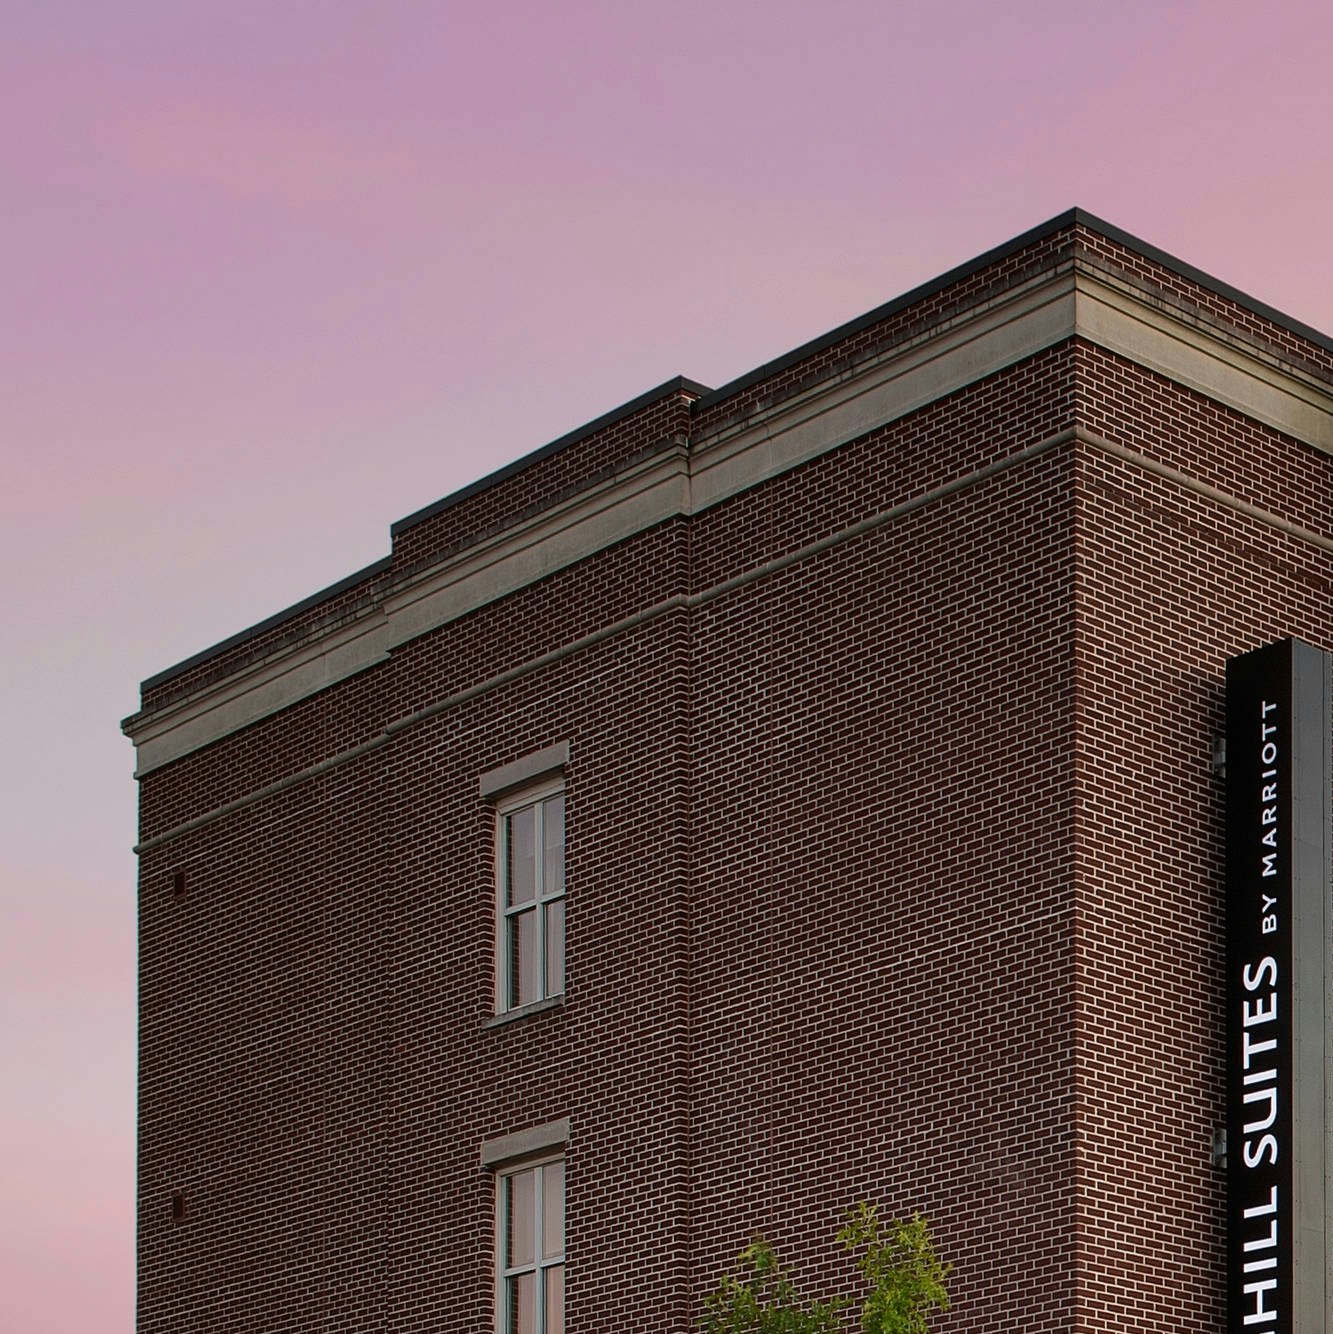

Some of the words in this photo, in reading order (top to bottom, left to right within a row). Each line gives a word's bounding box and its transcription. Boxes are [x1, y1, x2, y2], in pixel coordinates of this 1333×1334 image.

[1261, 700, 1277, 877] MARRIOTT
[1262, 893, 1277, 935] BY
[1243, 956, 1278, 1168] SUITES
